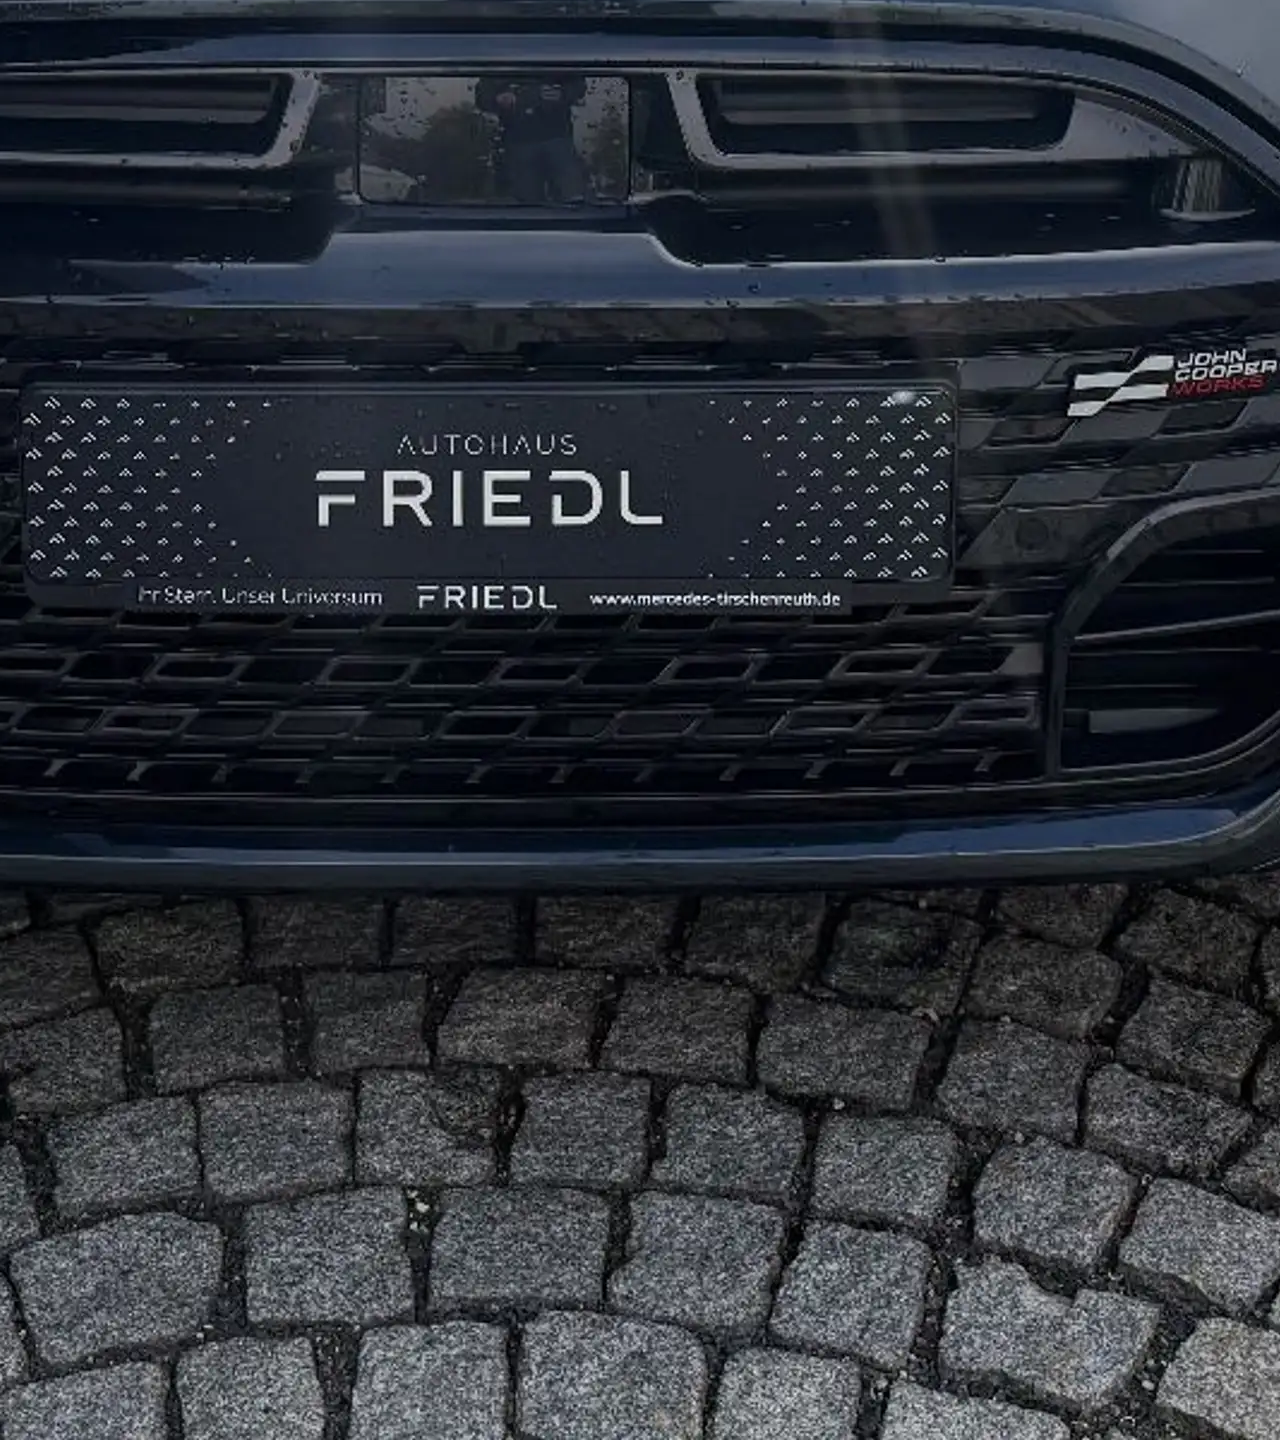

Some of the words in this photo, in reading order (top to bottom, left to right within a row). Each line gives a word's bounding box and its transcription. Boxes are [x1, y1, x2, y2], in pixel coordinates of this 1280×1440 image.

[1177, 348, 1247, 368] JOHN
[1174, 360, 1277, 382] COOPER
[1172, 374, 1265, 396] WORKS
[397, 434, 577, 456] AUTOHAUS
[315, 470, 663, 527] FRIEDL
[221, 587, 276, 604] Unser
[281, 586, 383, 606] Universum
[416, 585, 558, 610] FRIEDL
[589, 590, 841, 608] www.mercedes-tirschenreuth.de
